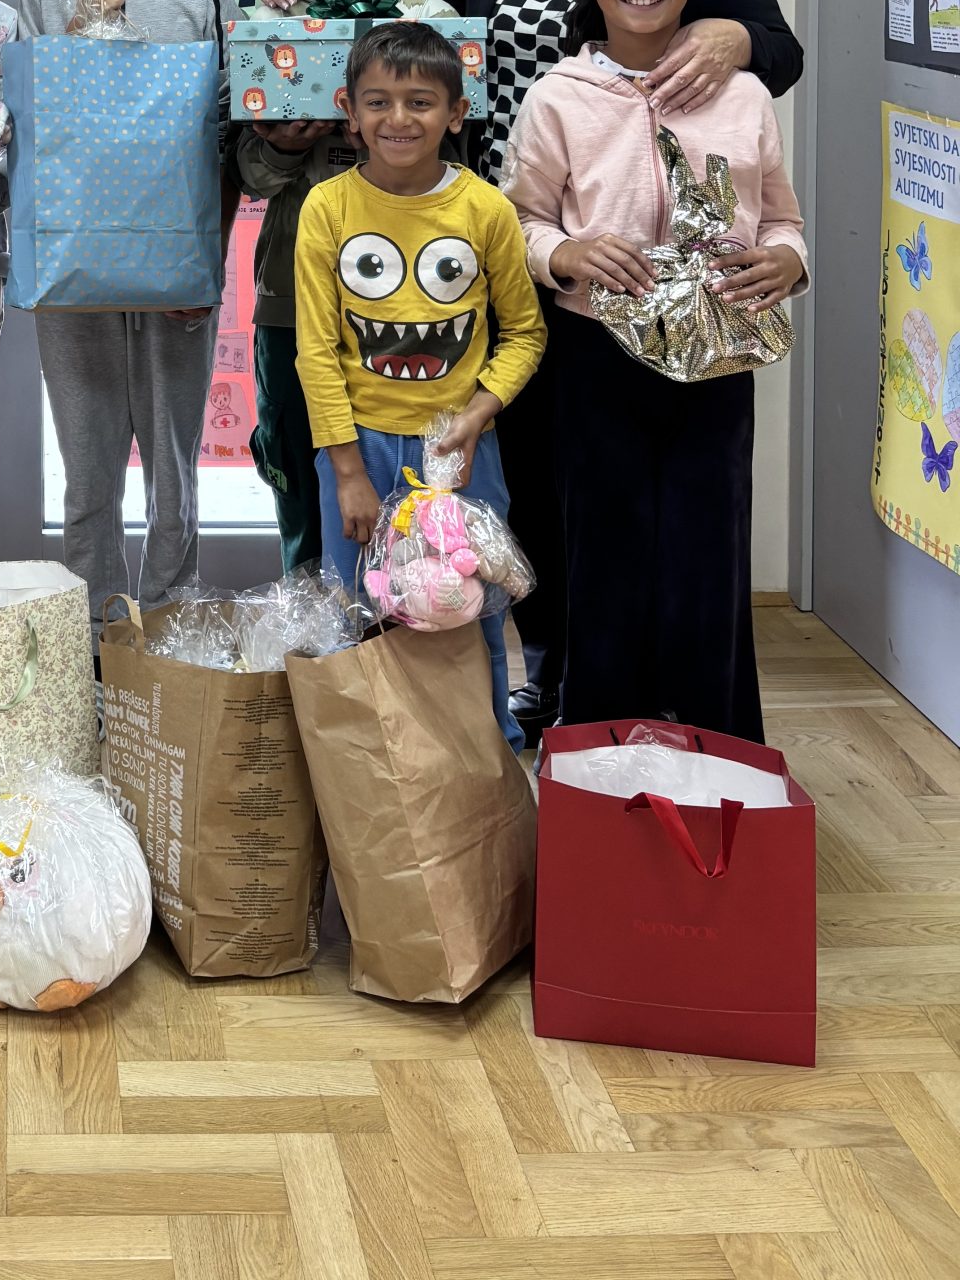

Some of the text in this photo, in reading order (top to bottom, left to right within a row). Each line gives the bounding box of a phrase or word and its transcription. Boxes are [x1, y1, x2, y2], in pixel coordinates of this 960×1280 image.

[894, 120, 960, 157] SVJETSKI DA
[895, 148, 956, 185] SVJESNOSTI
[895, 178, 944, 210] AUTIZMU
[108, 719, 186, 760] VAGYOK ÖNMAGAM
[110, 734, 131, 751] NEKAJ
[121, 752, 146, 776] SONO
[148, 766, 156, 790] KJER
[155, 756, 168, 866] TU SOM ČLOVEKOM
